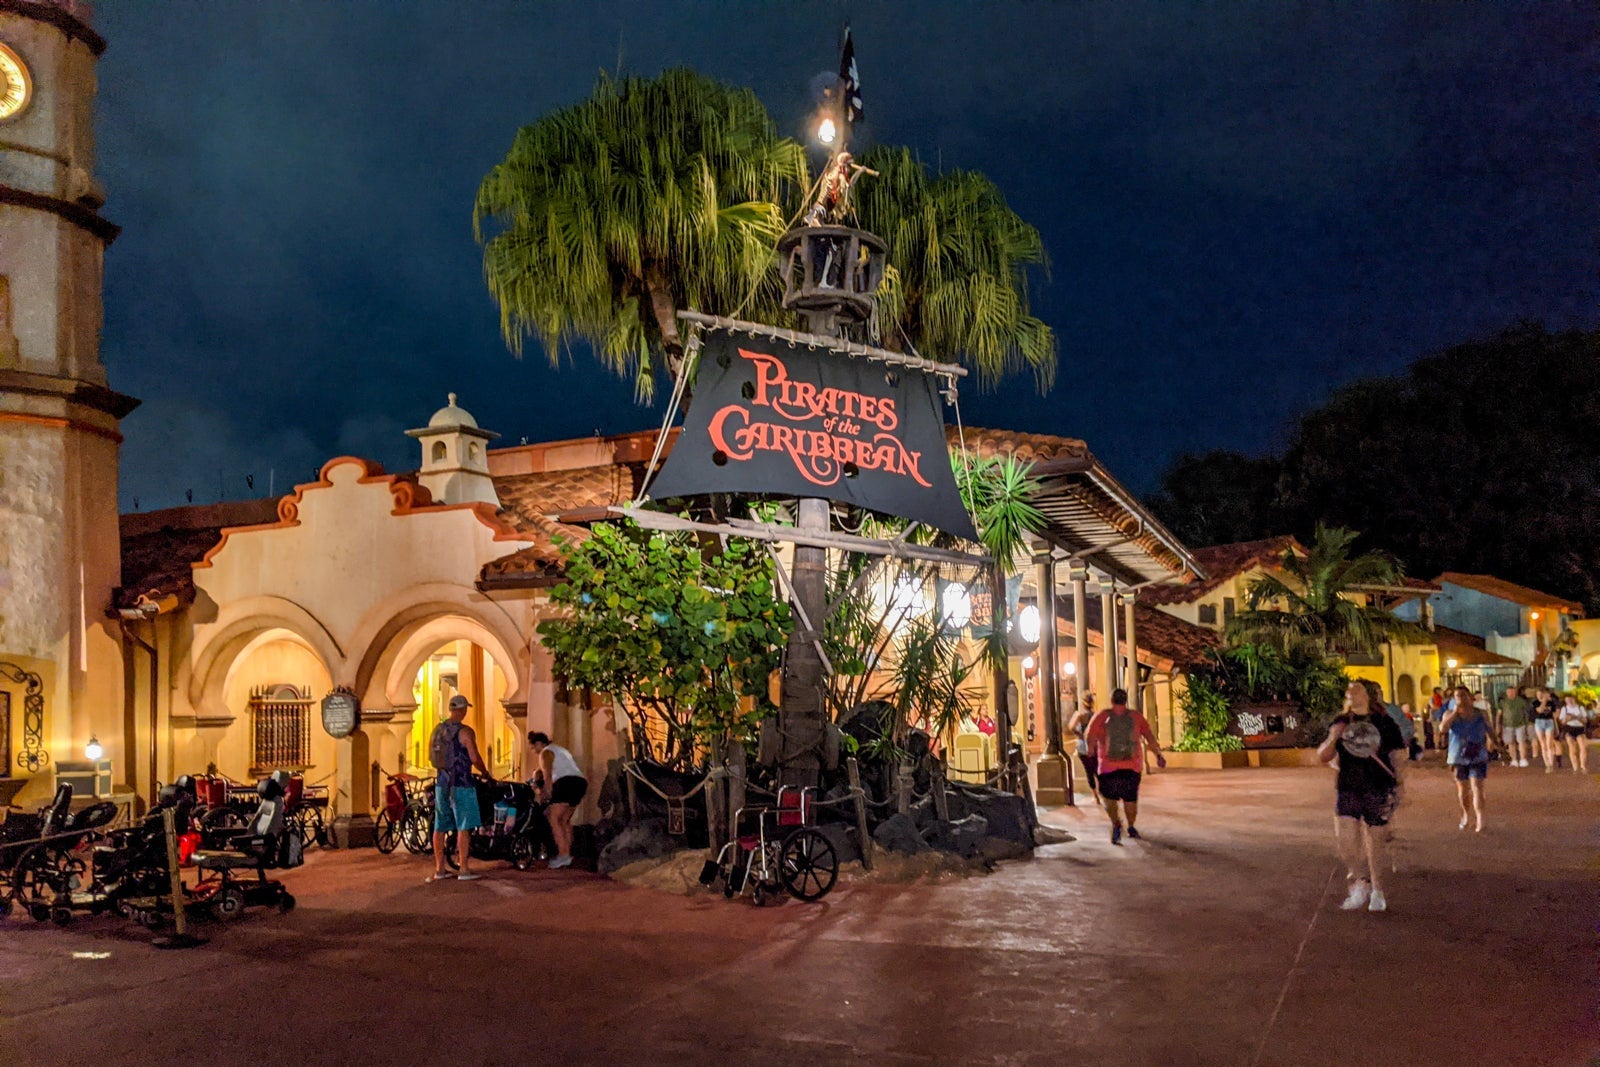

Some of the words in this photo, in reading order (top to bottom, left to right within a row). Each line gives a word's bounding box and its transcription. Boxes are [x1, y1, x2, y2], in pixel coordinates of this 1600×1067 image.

[737, 347, 898, 431] PIRATES
[823, 416, 835, 433] of
[837, 419, 861, 436] the
[707, 404, 933, 488] CARIBBEAN
